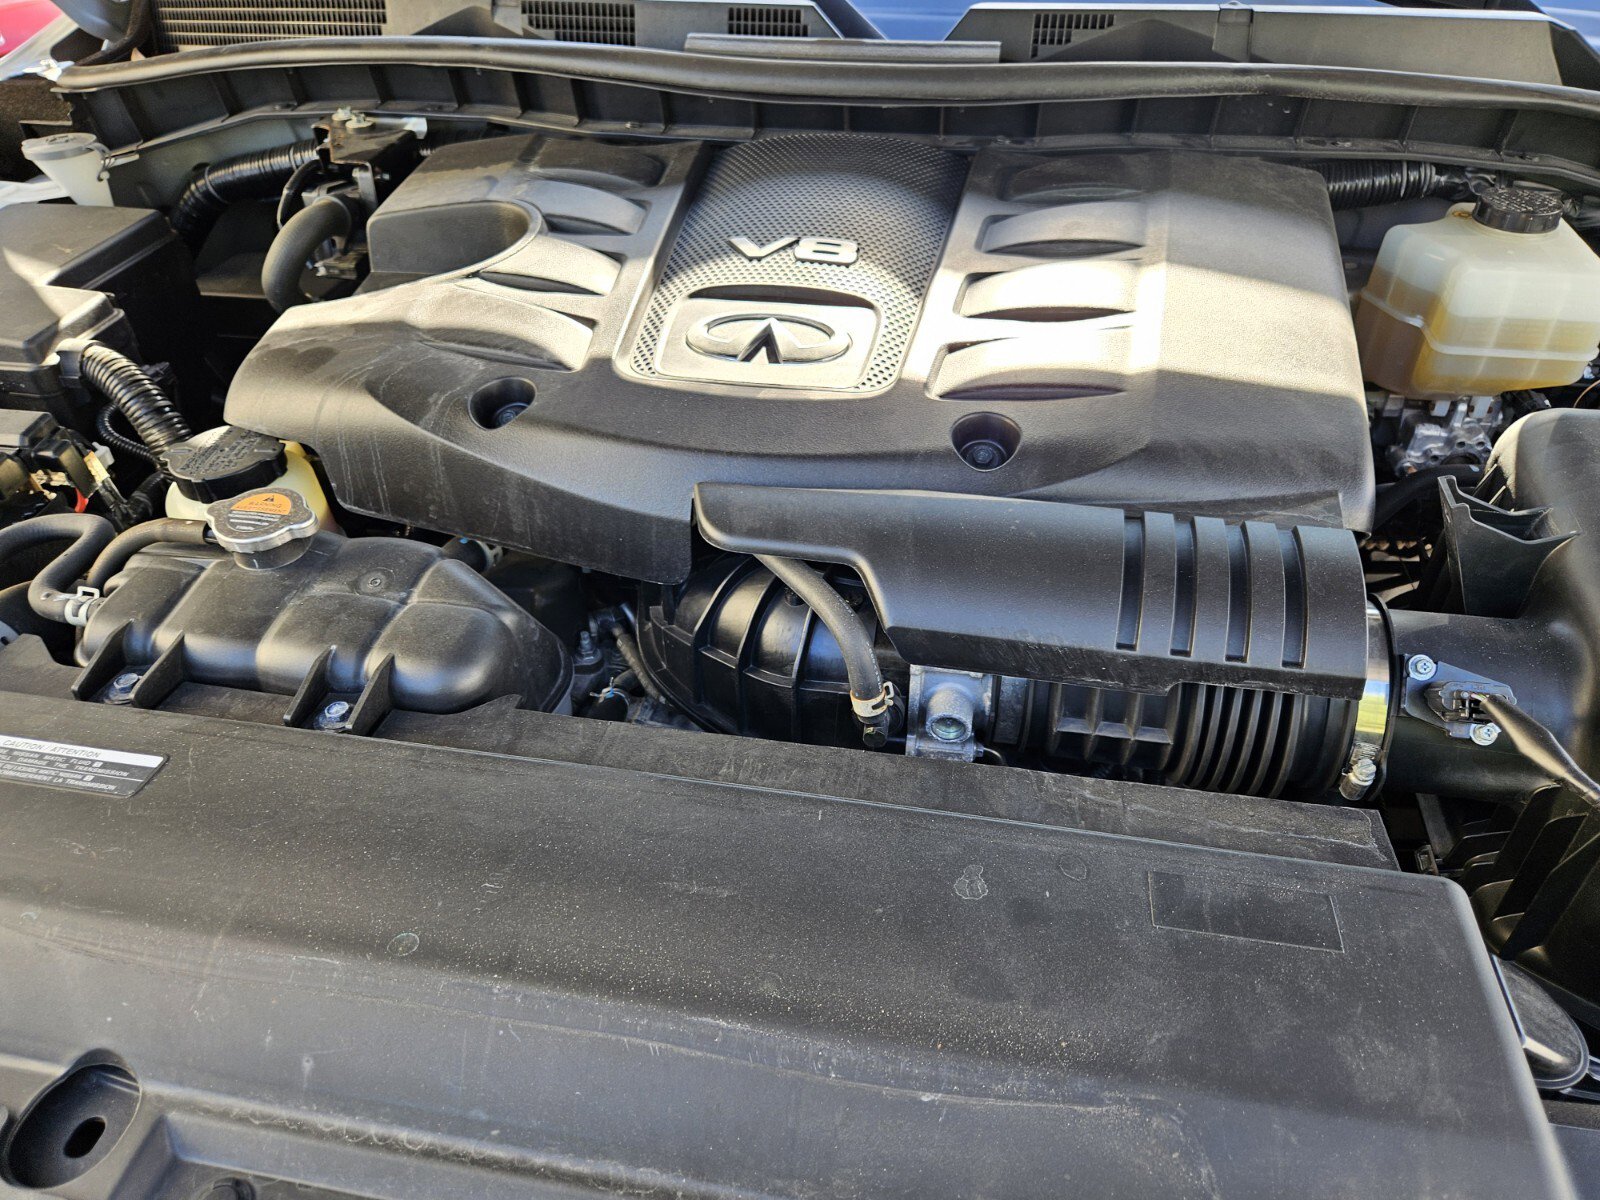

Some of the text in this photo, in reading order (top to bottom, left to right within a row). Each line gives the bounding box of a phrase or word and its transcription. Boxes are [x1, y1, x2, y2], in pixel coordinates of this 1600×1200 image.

[725, 236, 859, 267] V8
[3, 740, 43, 750] CAUTION
[50, 746, 102, 758] ATTENTION
